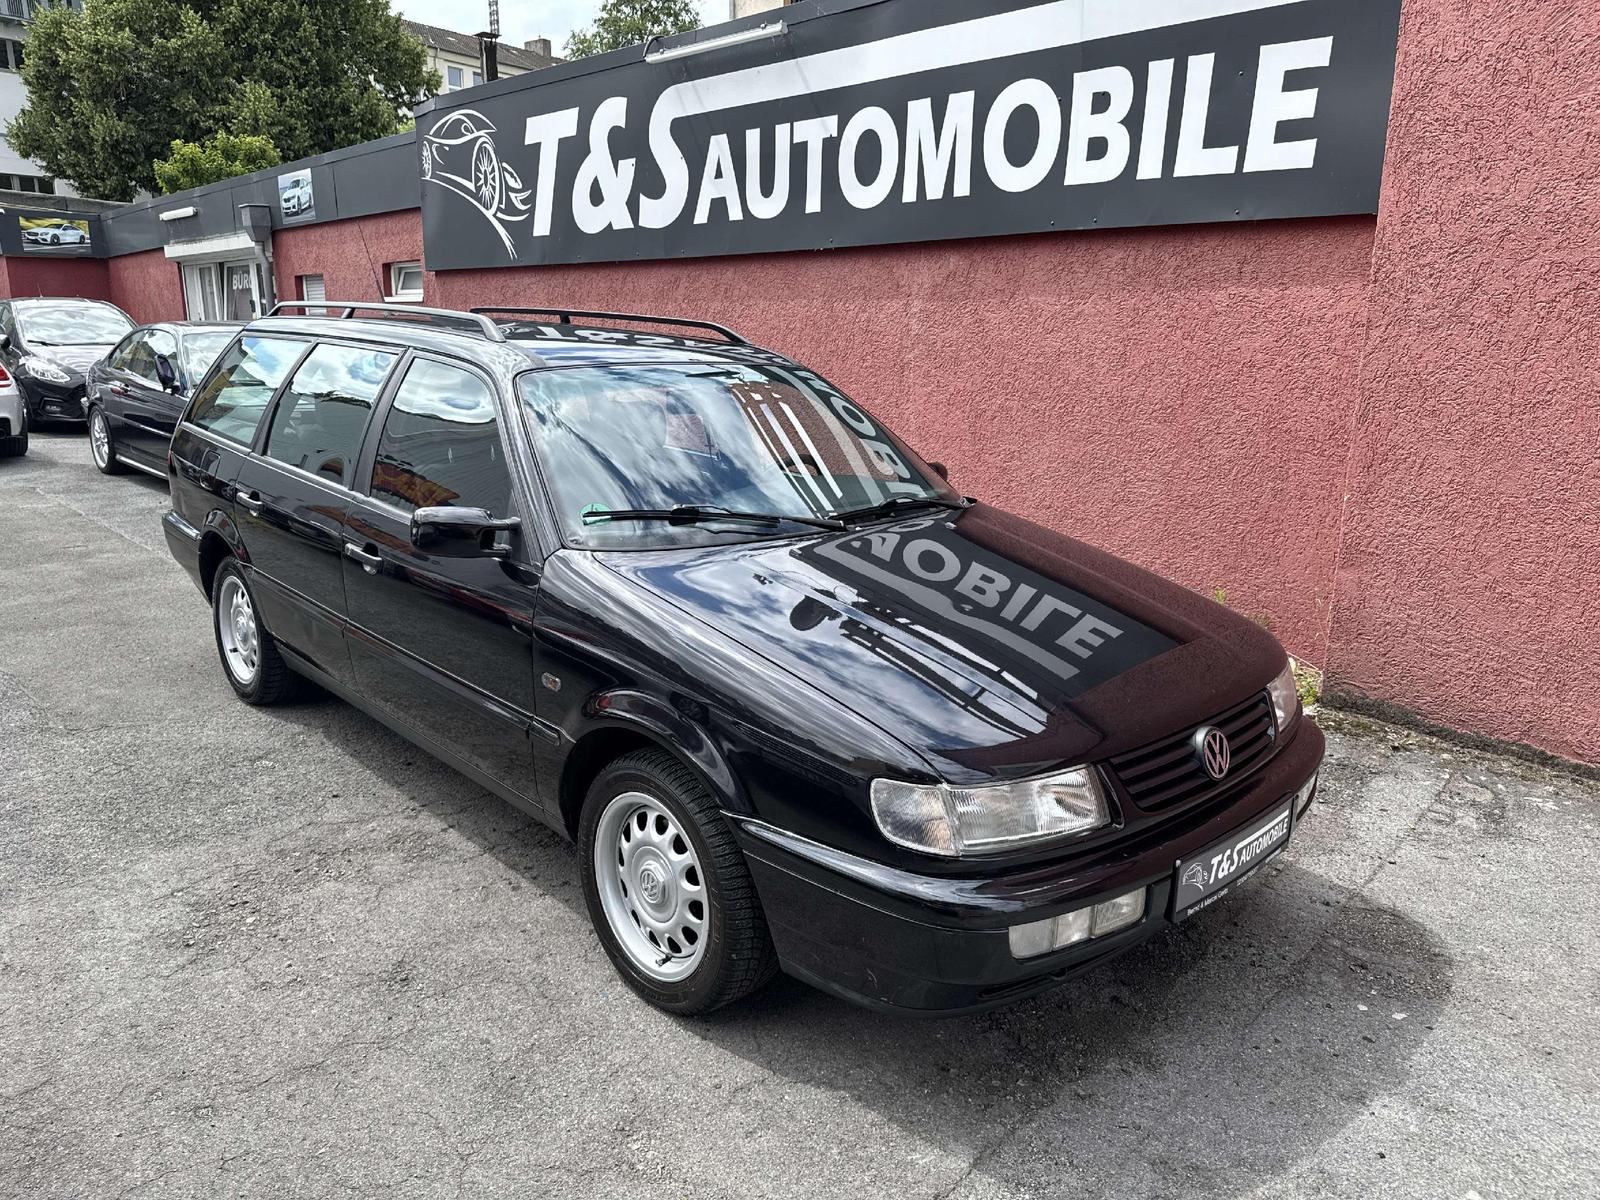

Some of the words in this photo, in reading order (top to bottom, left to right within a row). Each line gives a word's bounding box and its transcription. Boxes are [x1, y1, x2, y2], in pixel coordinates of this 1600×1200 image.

[524, 80, 698, 236] T&S
[693, 35, 1333, 225] AUTOMOBILE
[1209, 844, 1240, 884] T&S
[1239, 817, 1288, 866] AUTOMOBILE
